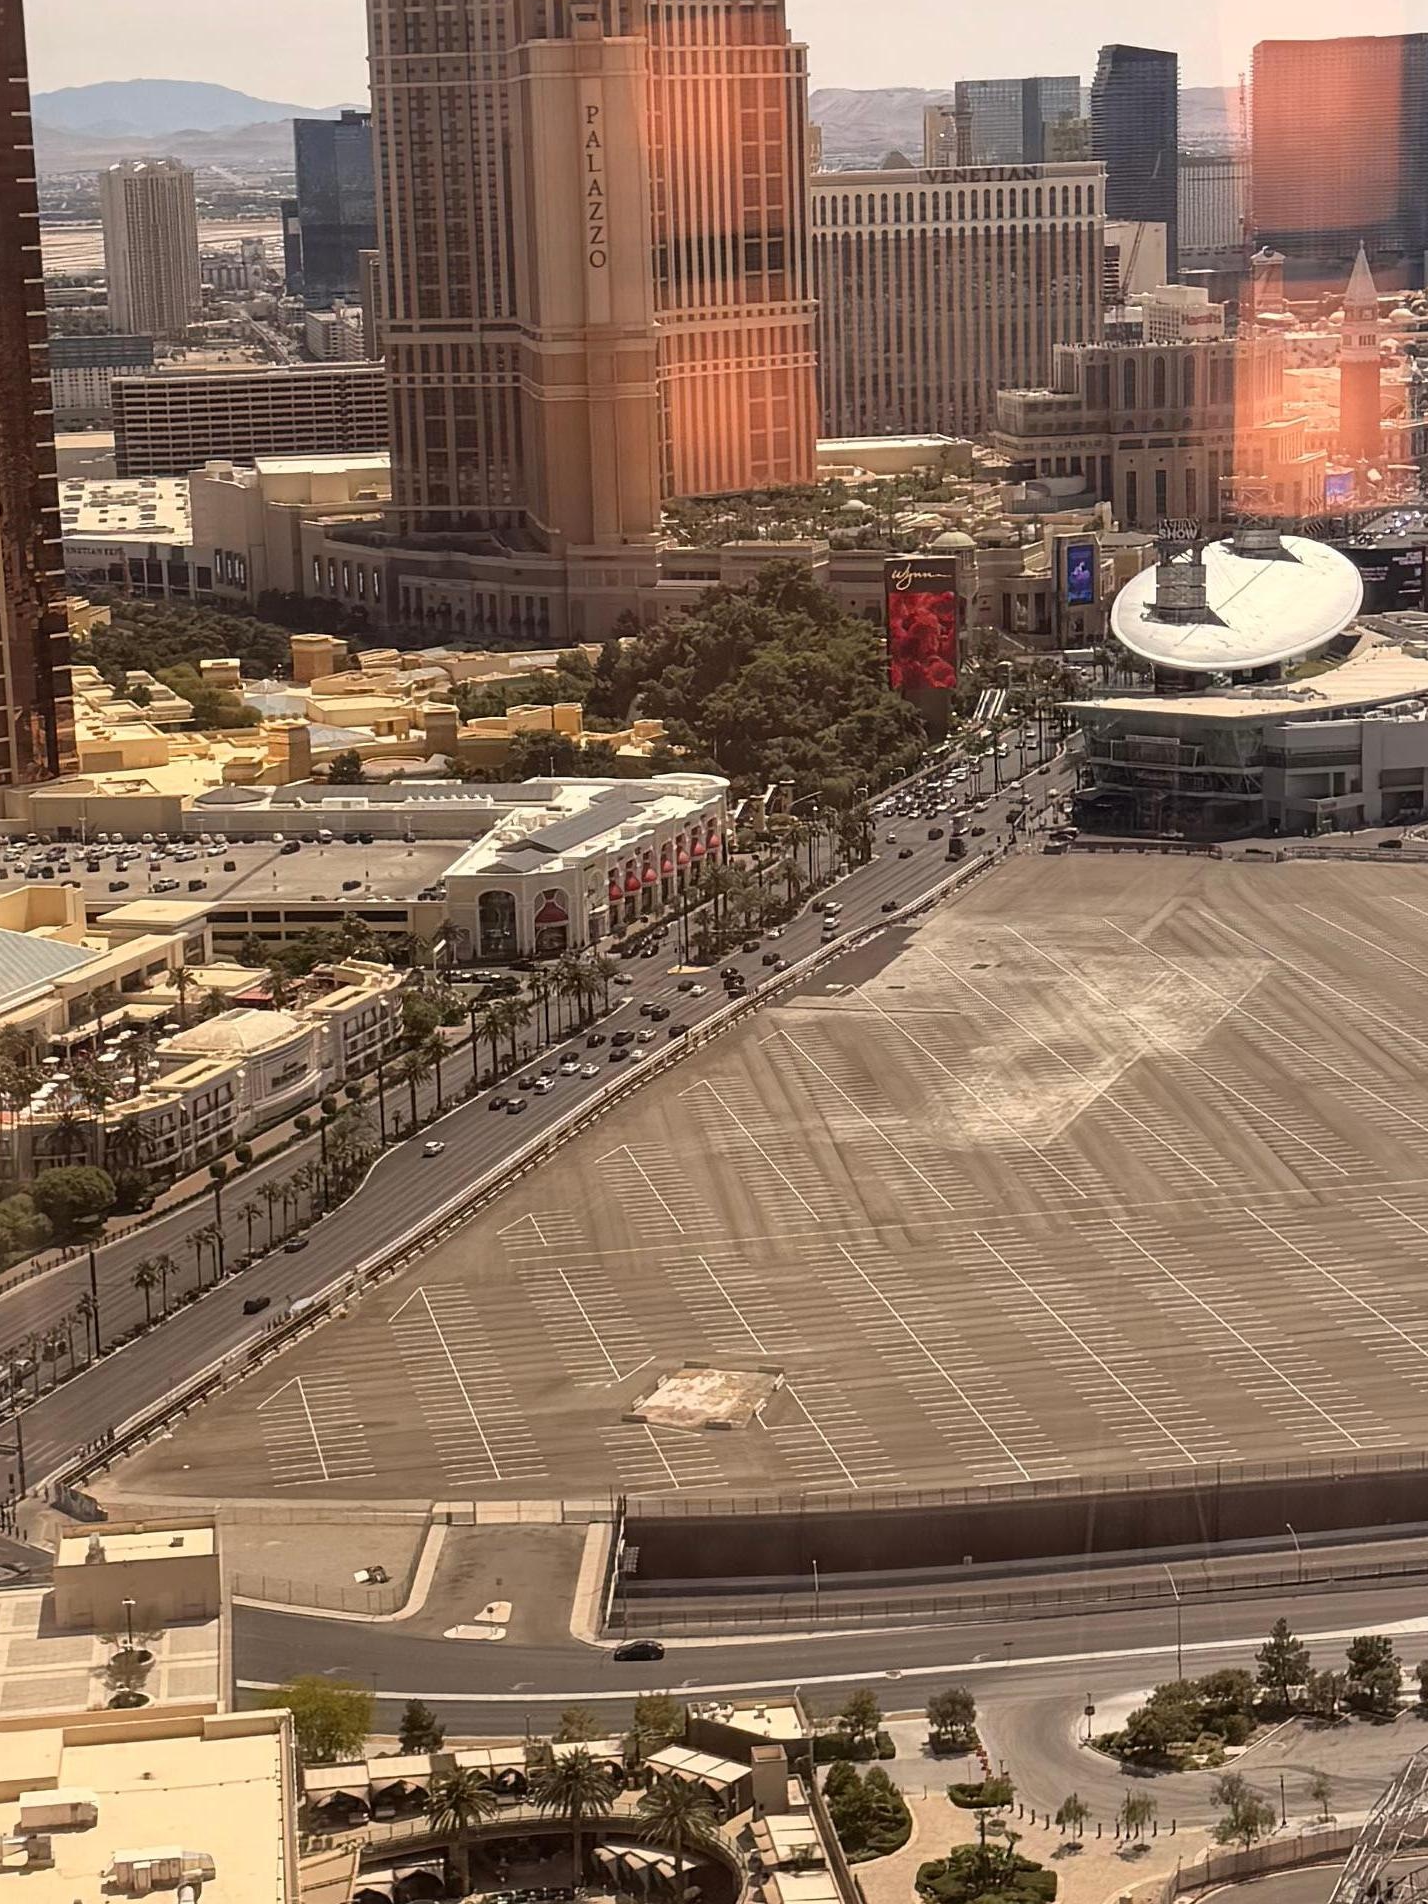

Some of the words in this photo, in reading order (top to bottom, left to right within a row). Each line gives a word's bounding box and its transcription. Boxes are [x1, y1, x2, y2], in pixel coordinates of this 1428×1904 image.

[926, 166, 1038, 185] VENETIAN
[585, 105, 607, 269] PALAZZO
[1158, 528, 1199, 541] SHOW
